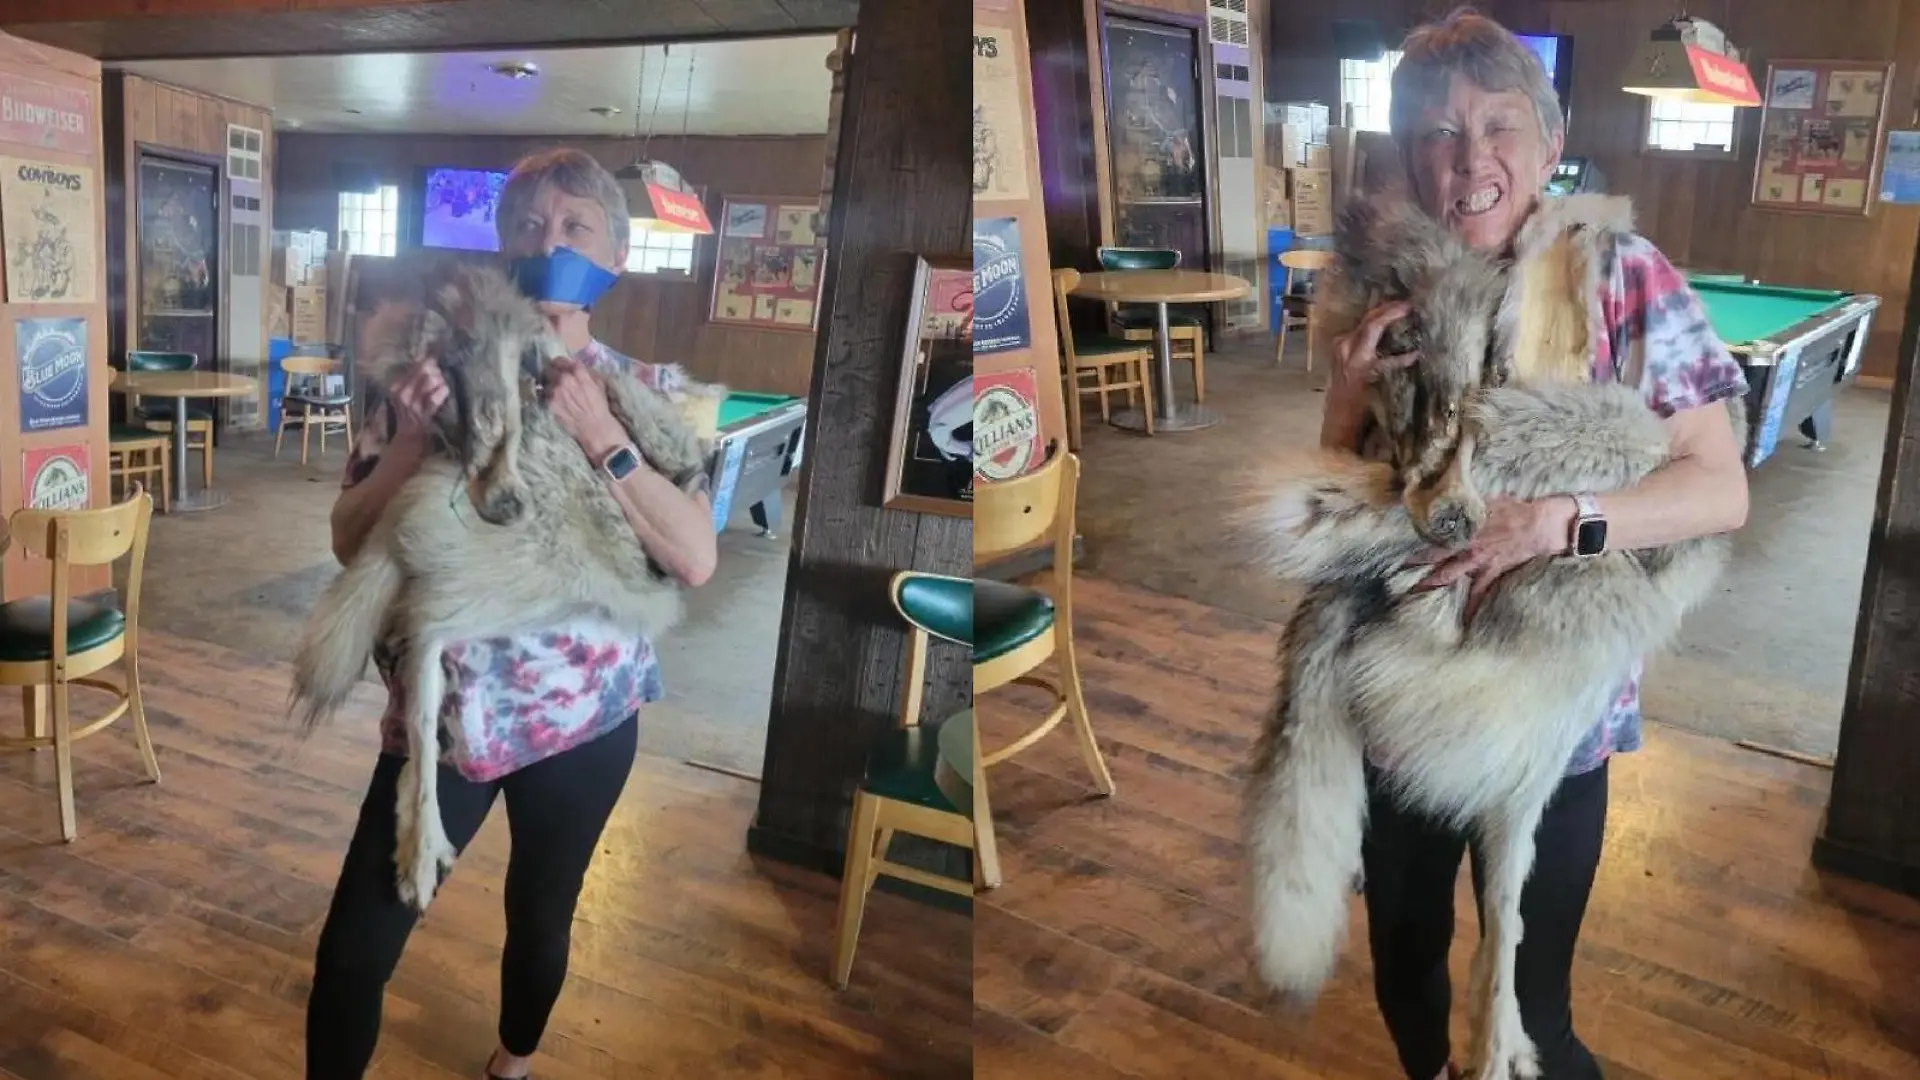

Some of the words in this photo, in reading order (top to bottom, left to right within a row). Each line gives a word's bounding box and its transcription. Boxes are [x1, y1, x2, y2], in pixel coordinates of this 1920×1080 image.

[3, 96, 84, 134] BUDWEISER
[18, 166, 81, 190] COWBOYS
[982, 257, 1016, 288] MOON
[23, 363, 54, 389] BLUE
[55, 352, 82, 374] MOON
